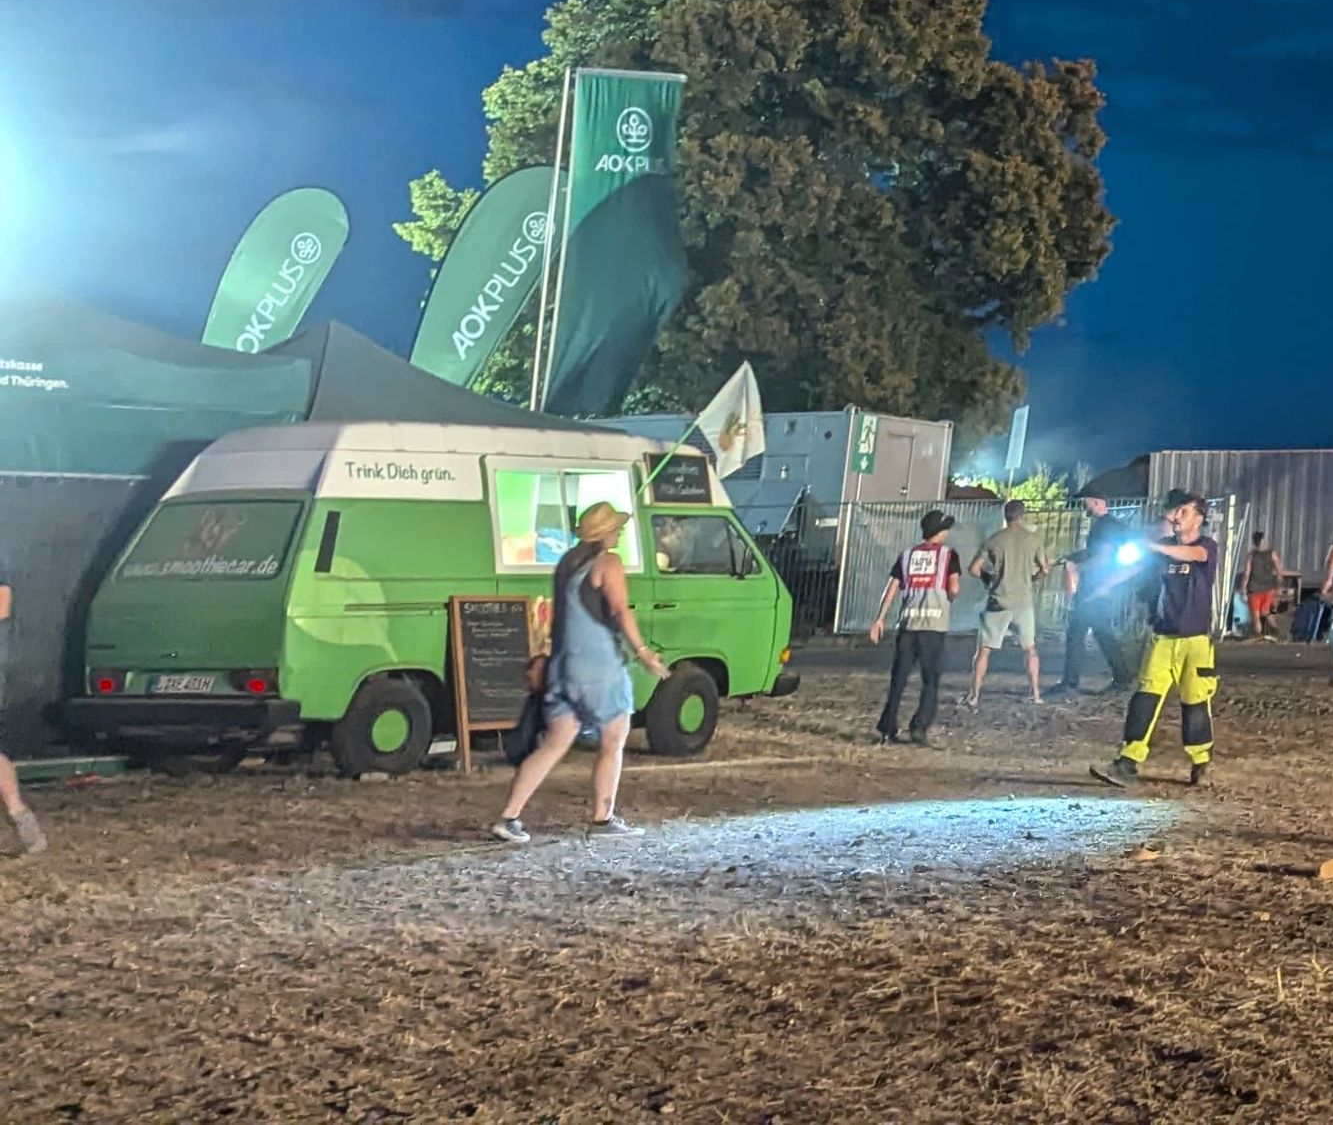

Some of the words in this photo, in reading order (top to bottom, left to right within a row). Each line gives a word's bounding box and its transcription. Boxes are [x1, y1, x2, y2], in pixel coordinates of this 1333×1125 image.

[236, 258, 304, 354] OKPLUS
[345, 461, 386, 479] Trink
[386, 462, 418, 480] Dich
